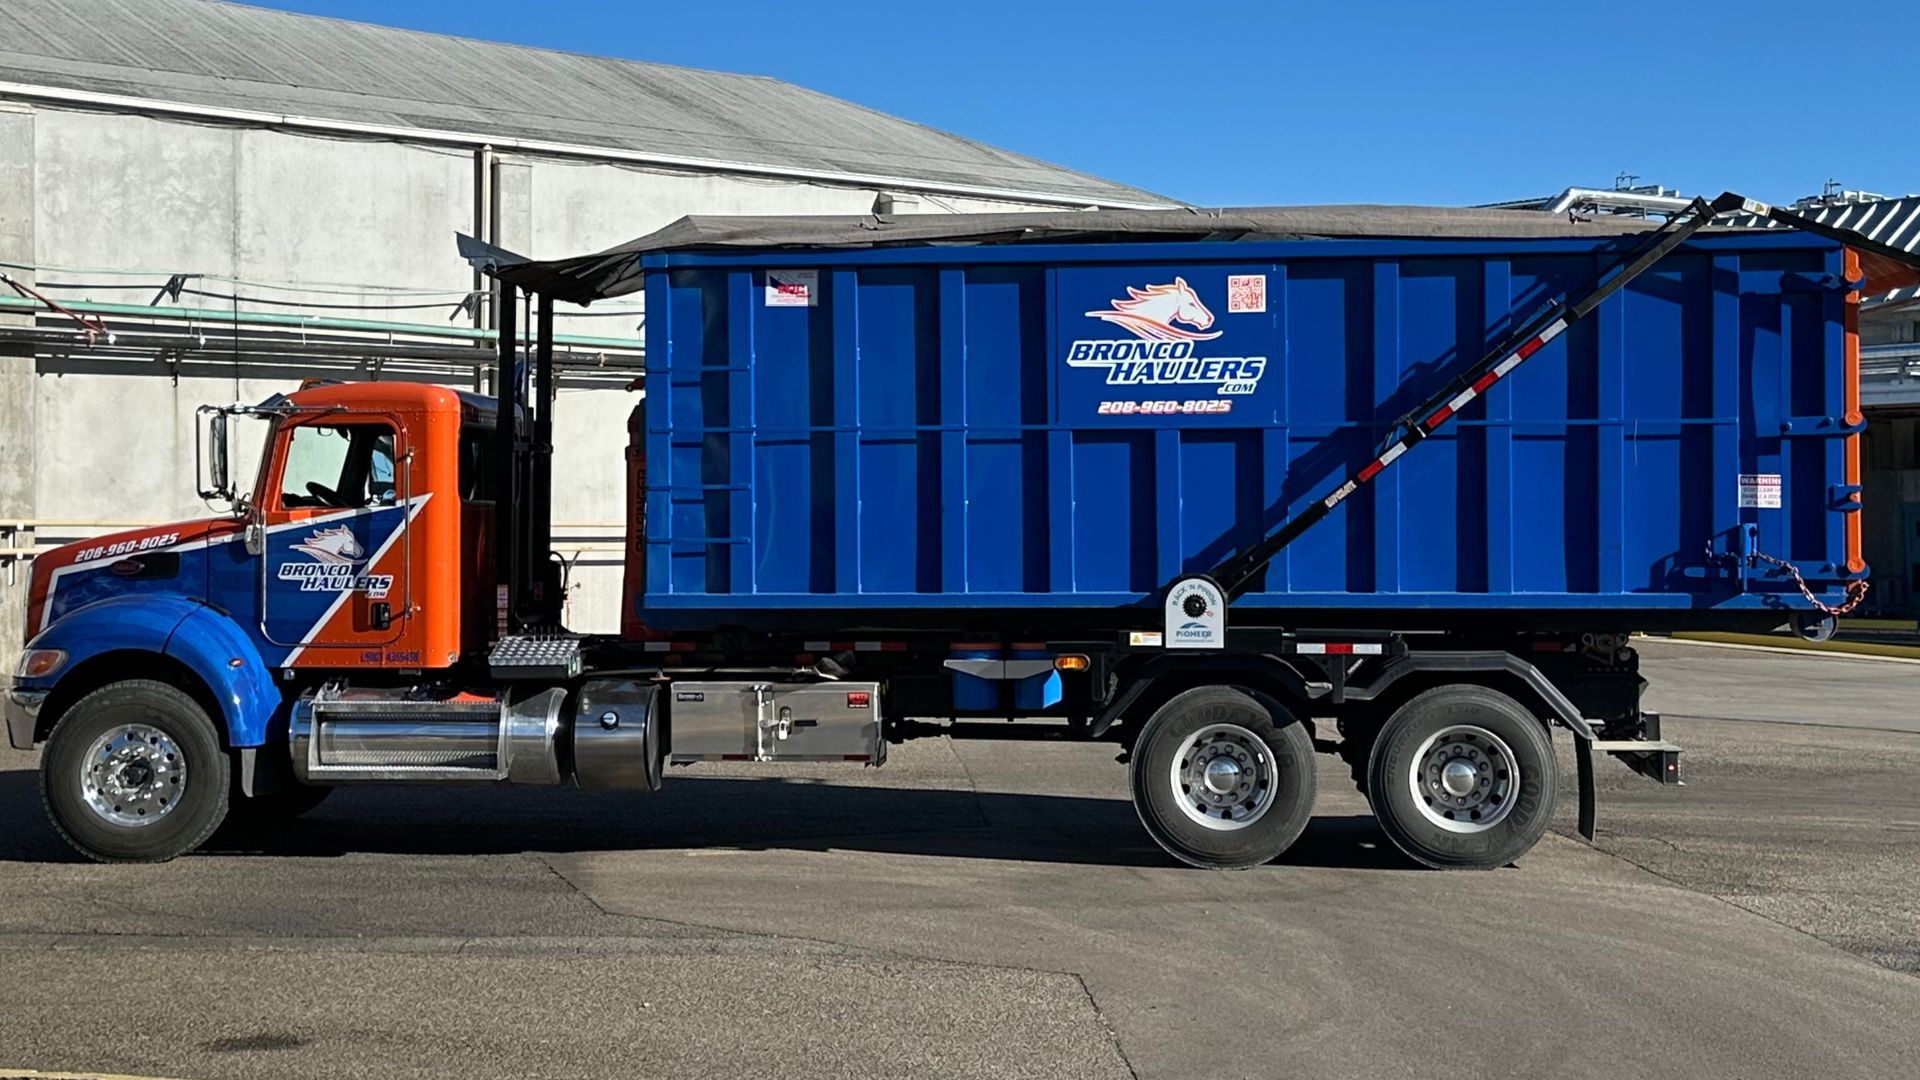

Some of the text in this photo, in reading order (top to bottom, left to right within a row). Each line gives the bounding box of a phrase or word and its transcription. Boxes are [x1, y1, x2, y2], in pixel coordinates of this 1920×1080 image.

[1069, 341, 1193, 364] BRONCO
[1108, 359, 1265, 382] HAULERS
[1218, 382, 1255, 394] .COM
[1098, 400, 1232, 414] 208-960-8025
[74, 532, 180, 563] 208-960-8025
[279, 564, 351, 578] BRONCO
[302, 576, 392, 590] HAULERS
[1176, 630, 1212, 638] PIONEER
